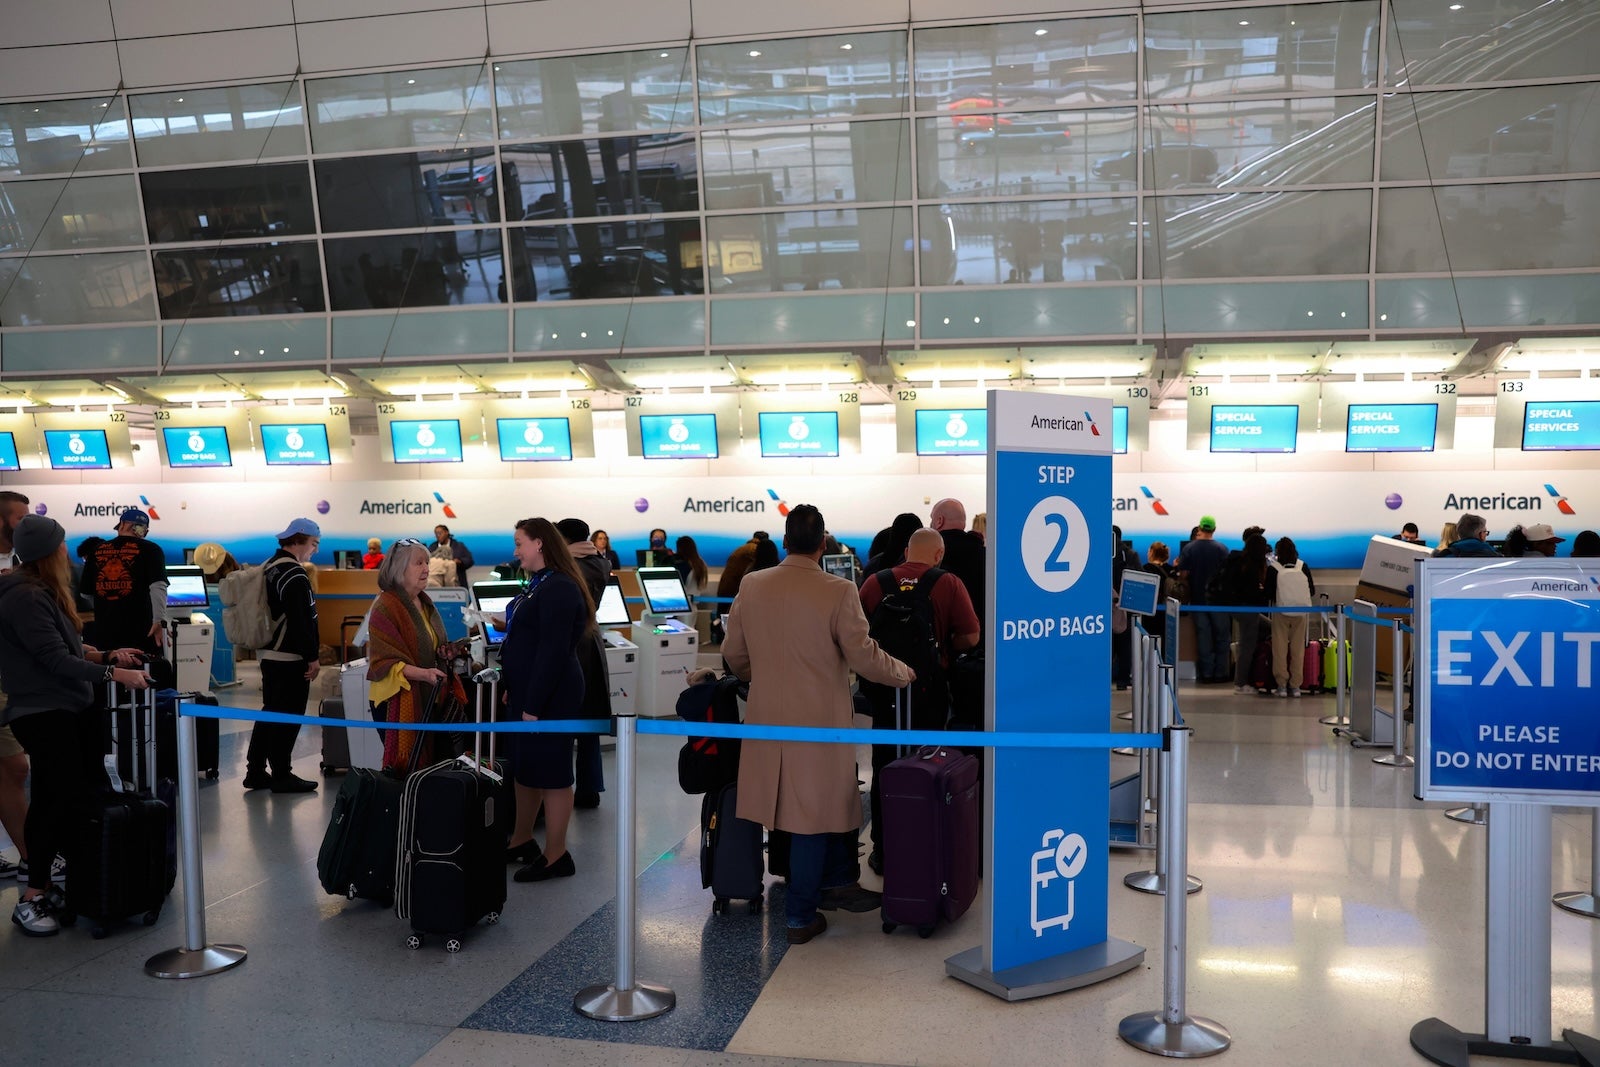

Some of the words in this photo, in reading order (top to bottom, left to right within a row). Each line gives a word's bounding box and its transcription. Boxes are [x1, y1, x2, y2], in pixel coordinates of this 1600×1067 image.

[1127, 387, 1148, 398] 130
[1190, 386, 1209, 396] 131
[1436, 383, 1456, 394] 132
[1502, 382, 1522, 393] 133
[839, 393, 858, 403] 128
[897, 391, 916, 401] 129
[571, 400, 590, 410] 126
[625, 397, 643, 407] 127
[329, 407, 346, 416] 124
[378, 405, 395, 414] 125
[1529, 409, 1573, 419] SPECIAL
[109, 413, 125, 422] 122
[153, 412, 170, 421] 123
[1215, 413, 1257, 422] SPECIAL
[1352, 411, 1394, 421] SPECIAL
[1030, 414, 1084, 431] American
[1528, 422, 1580, 432] SERVICES
[1214, 426, 1262, 435] SERVICES
[1351, 424, 1400, 434] SERVICES
[1038, 465, 1075, 484] STEP
[359, 499, 432, 515] American
[683, 497, 765, 513] American
[1443, 493, 1542, 511] American
[1044, 513, 1070, 573] 2
[1531, 581, 1588, 592] American
[1003, 617, 1055, 640] DROP
[1060, 614, 1105, 637] BAGS
[1437, 630, 1600, 688] EXIT
[1479, 724, 1560, 744] PLEASE
[1436, 751, 1470, 769] DO
[1476, 752, 1525, 770] NOT
[1531, 753, 1600, 773] ENTER
